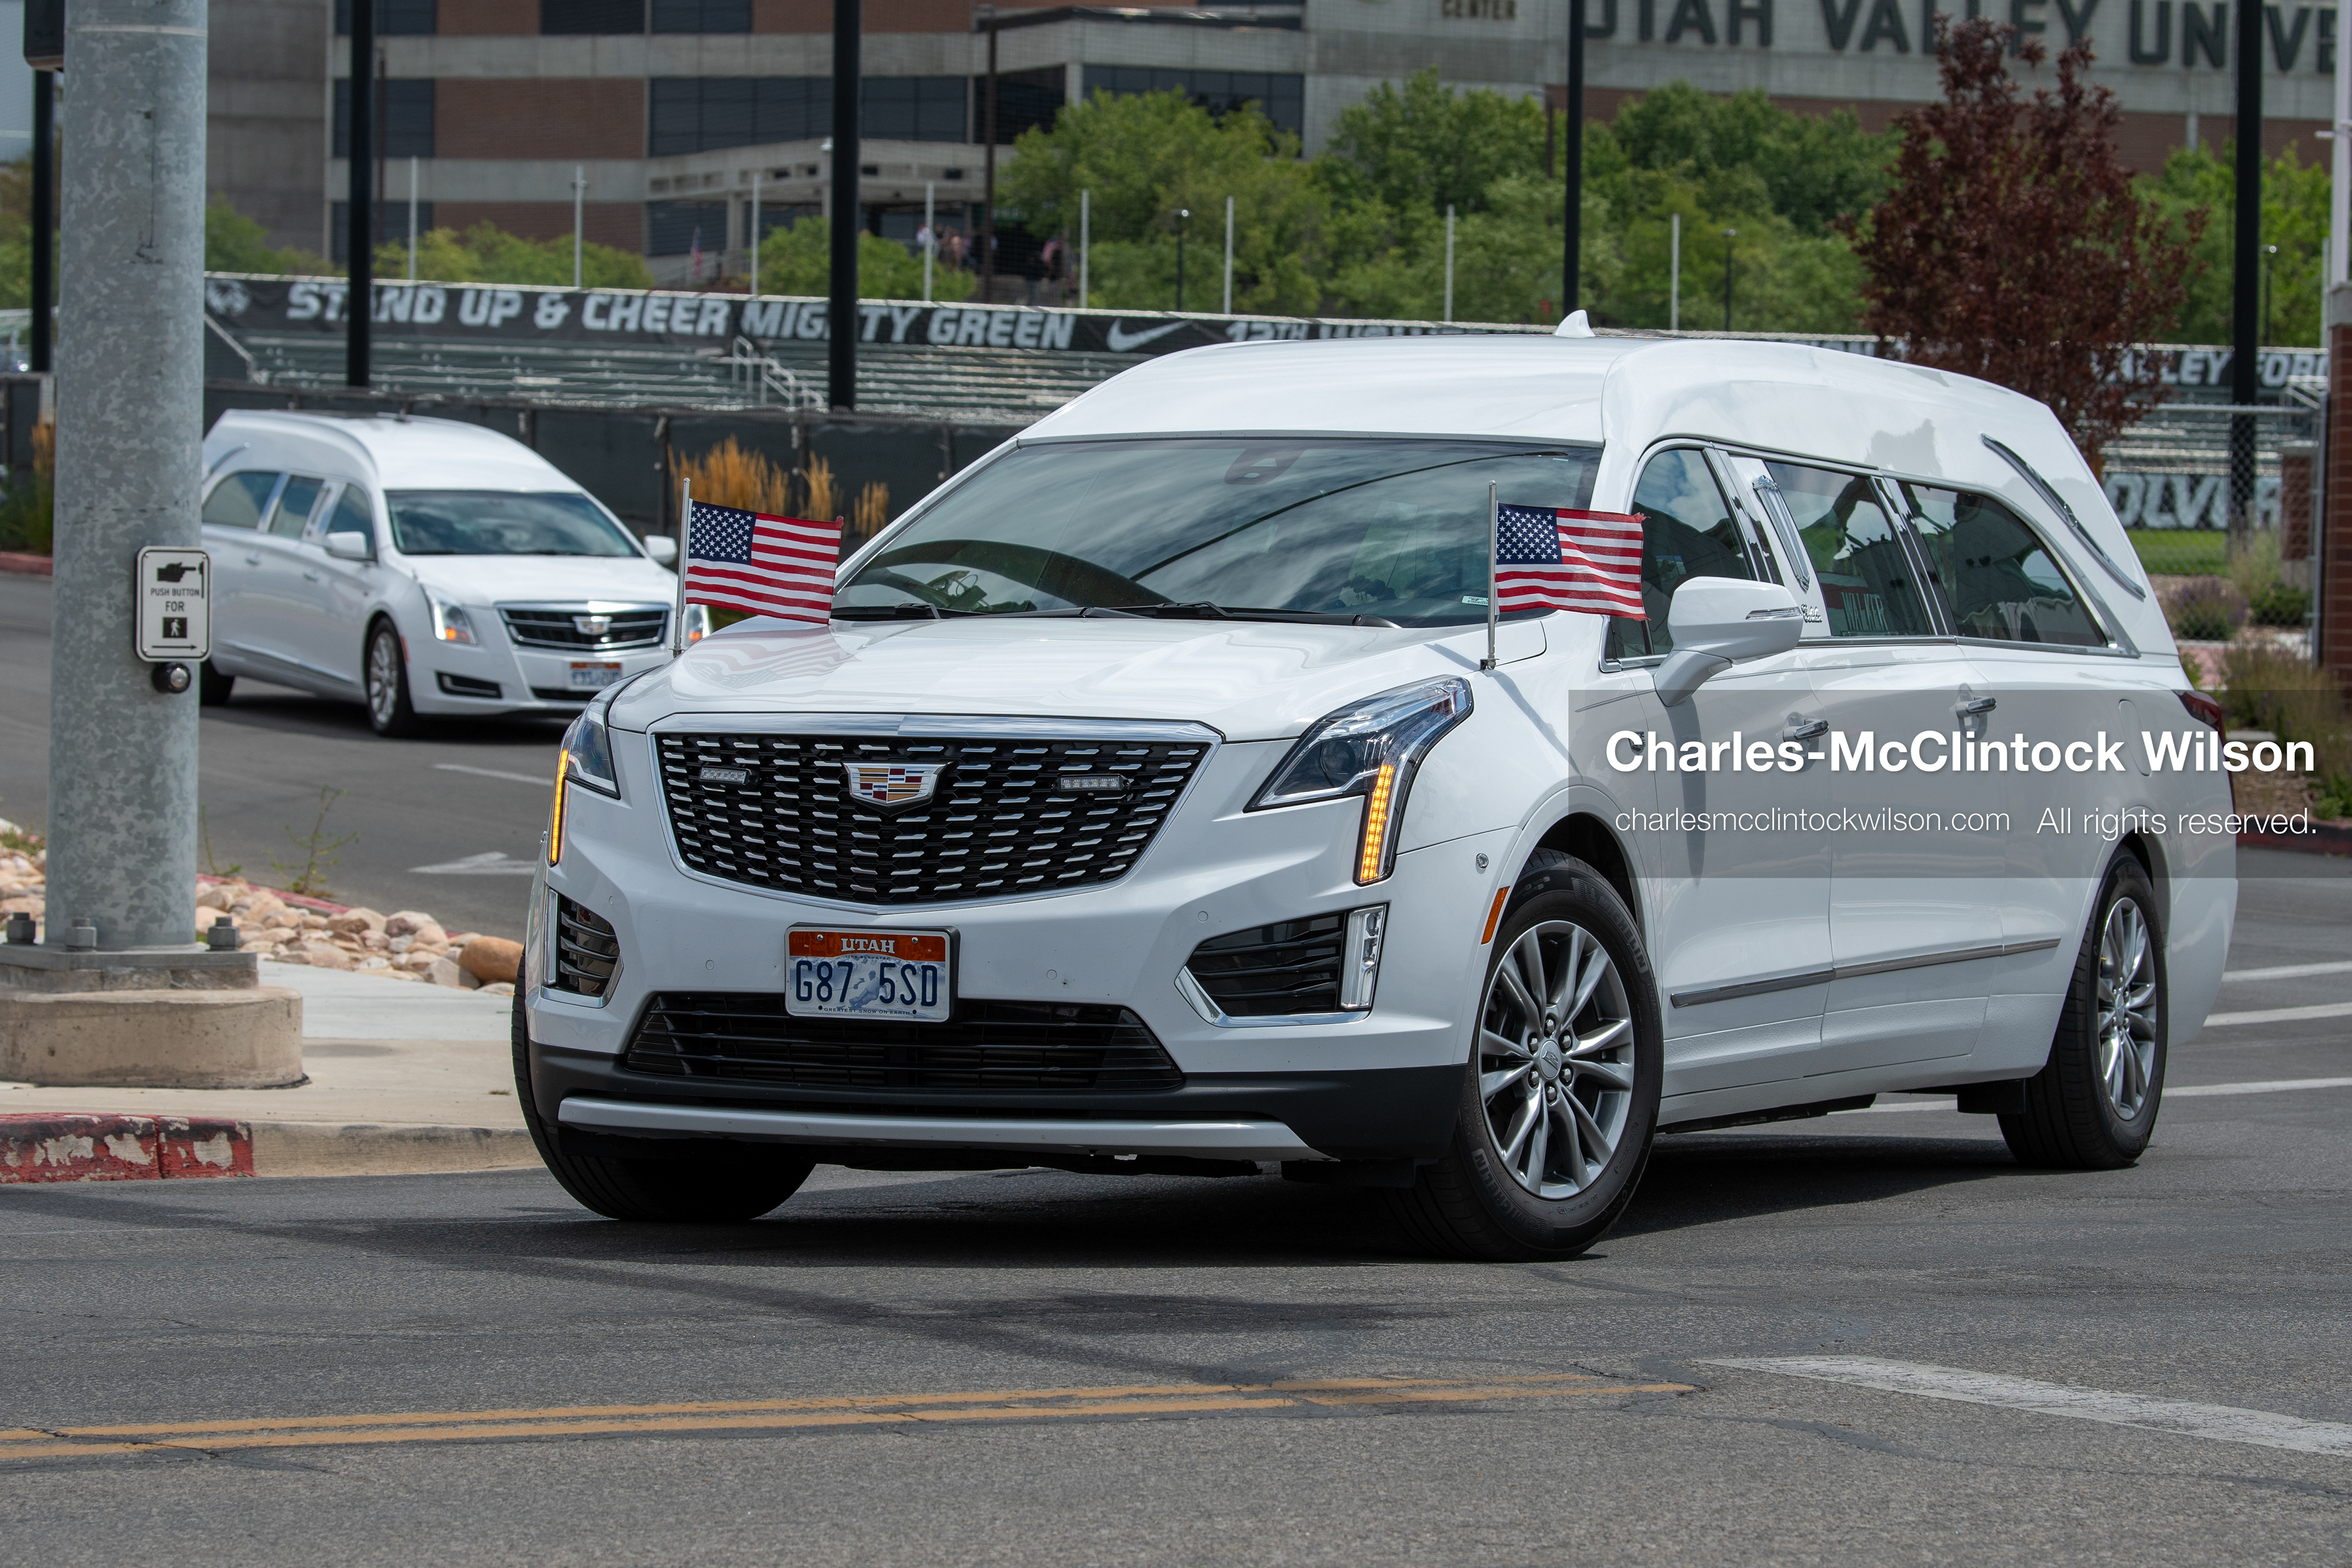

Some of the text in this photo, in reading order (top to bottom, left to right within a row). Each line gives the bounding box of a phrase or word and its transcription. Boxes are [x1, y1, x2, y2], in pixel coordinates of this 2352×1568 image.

[1822, 0, 2096, 57] VALEY
[2130, 1, 2336, 73] UNVE
[287, 282, 447, 325] STND
[458, 289, 524, 328] UP
[533, 292, 571, 330] &
[582, 293, 731, 336] CHEER
[740, 301, 920, 344] MIGTY
[927, 309, 1076, 351] GREEN
[2256, 354, 2328, 387] OR
[165, 601, 184, 611] FOR
[172, 588, 200, 597] BUTTON
[1841, 592, 1889, 631] WALKER
[840, 938, 896, 954] UTAH
[1597, 895, 1648, 969] MICHELIN
[796, 960, 938, 1007] G87 5SD
[1473, 1153, 1528, 1226] MICHELIN
